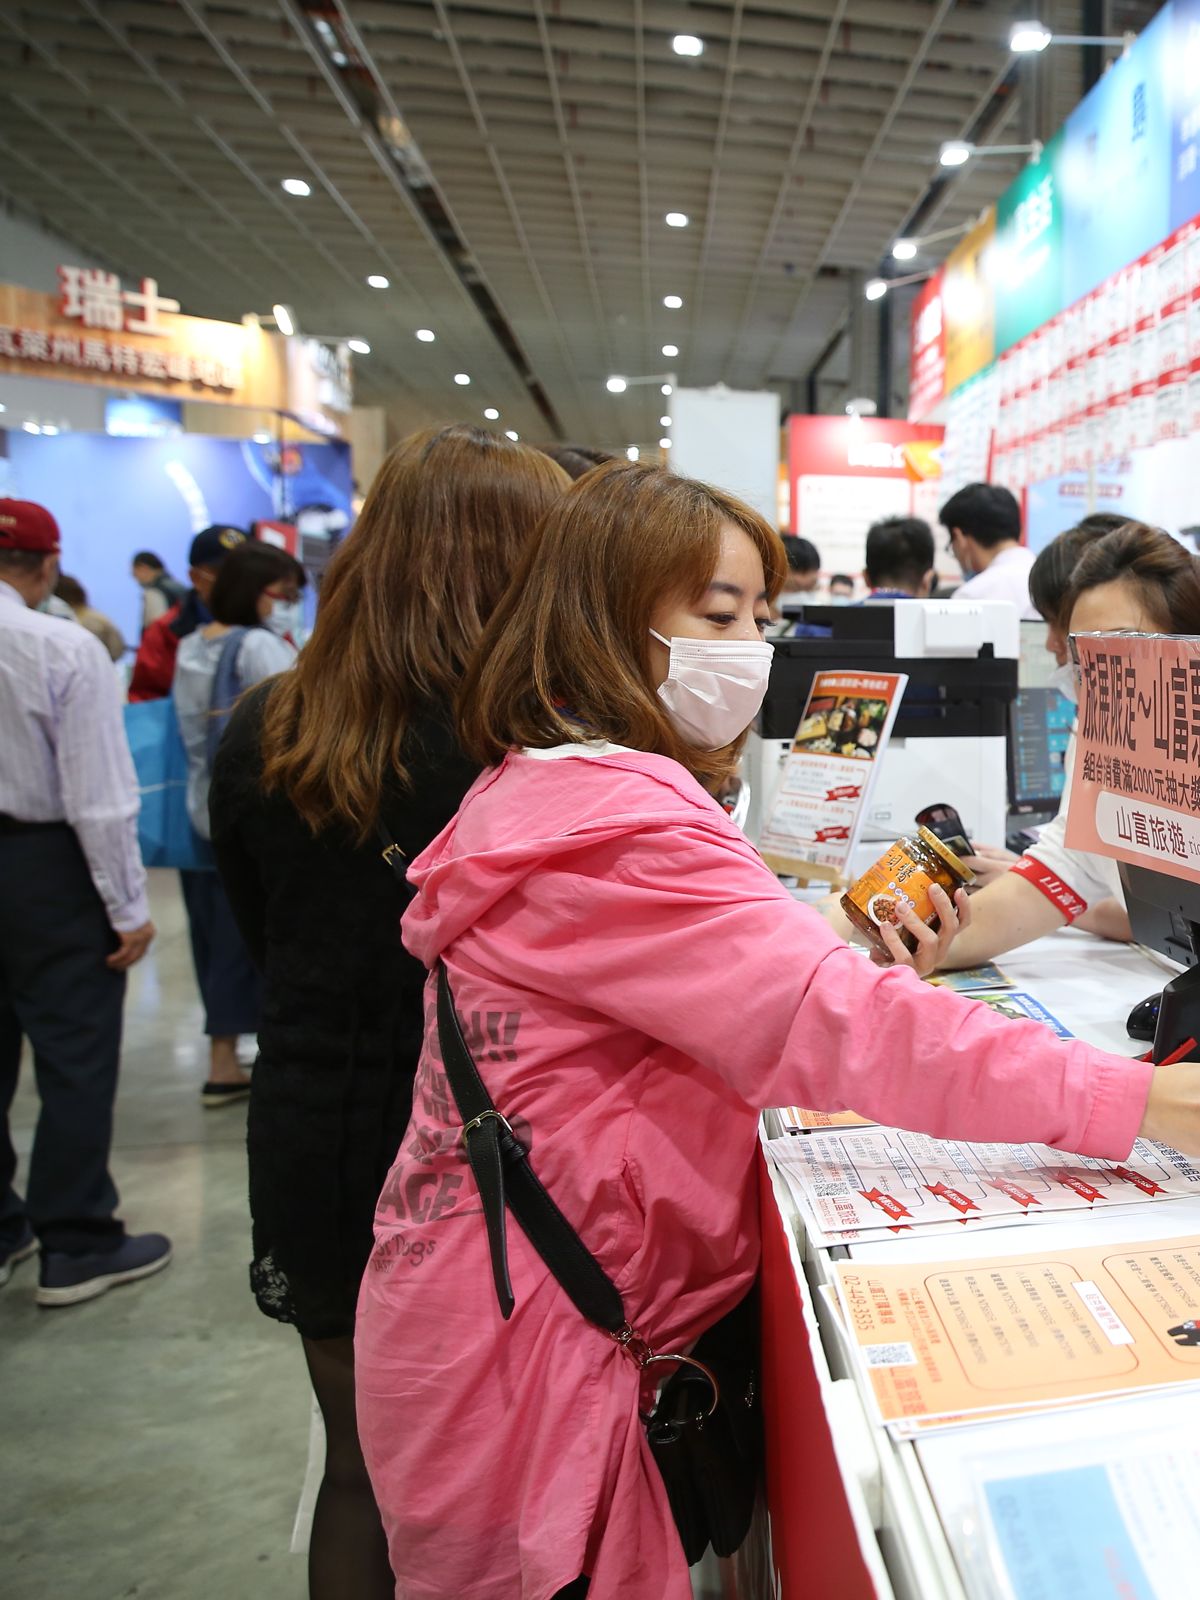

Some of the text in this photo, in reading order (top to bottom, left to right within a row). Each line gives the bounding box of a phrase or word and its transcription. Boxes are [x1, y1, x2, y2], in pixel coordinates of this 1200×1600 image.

[58, 265, 181, 337] 瑞士
[1116, 806, 1189, 859] 山富旅遊
